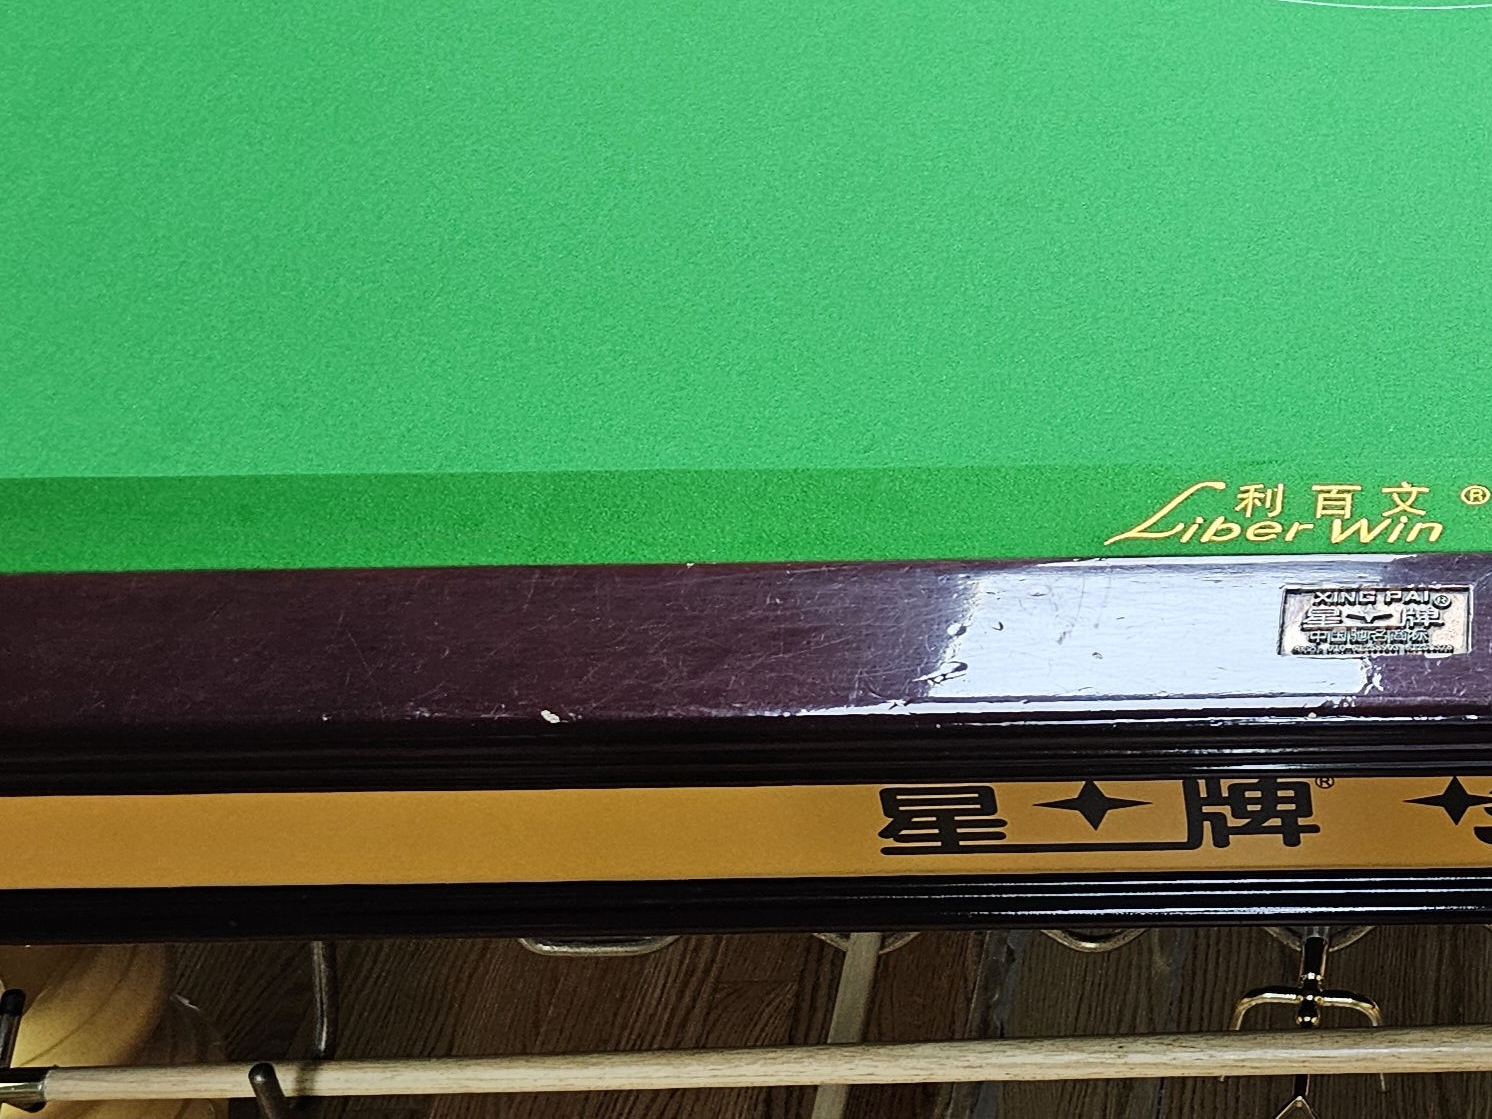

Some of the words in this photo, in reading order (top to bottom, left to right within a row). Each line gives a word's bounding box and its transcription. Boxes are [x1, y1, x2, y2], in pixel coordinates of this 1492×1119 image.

[1235, 482, 1430, 519] 利百文
[1314, 590, 1377, 605] XING
[1385, 590, 1430, 604] PAI
